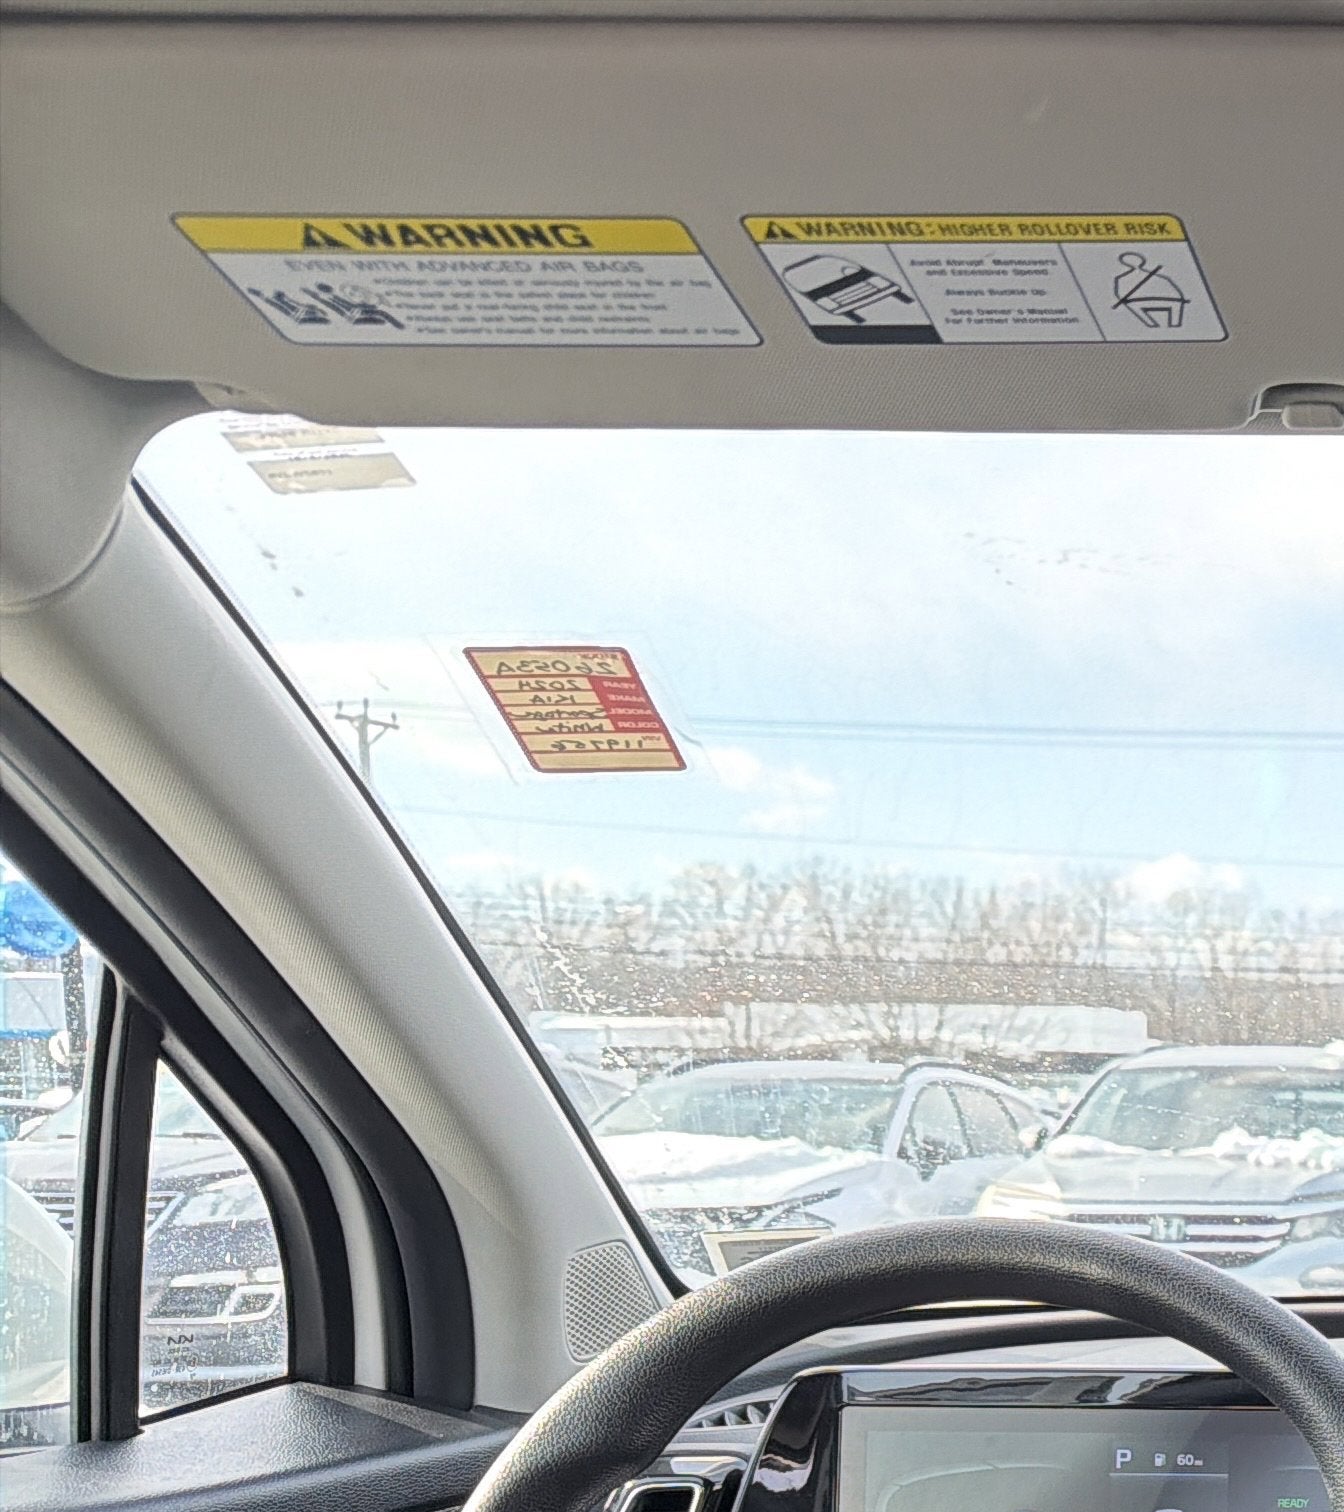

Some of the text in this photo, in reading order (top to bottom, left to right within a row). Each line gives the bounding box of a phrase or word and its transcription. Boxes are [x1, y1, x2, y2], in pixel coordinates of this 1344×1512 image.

[342, 222, 594, 249] WARNING
[938, 222, 1013, 237] HIGHER
[1018, 222, 1117, 237] ROLLOVER
[1125, 222, 1171, 237] RISK
[284, 260, 645, 273] EVEN WITH ADVANCED AIR BAGS
[1115, 1449, 1132, 1469] P
[1277, 1498, 1310, 1509] READY
